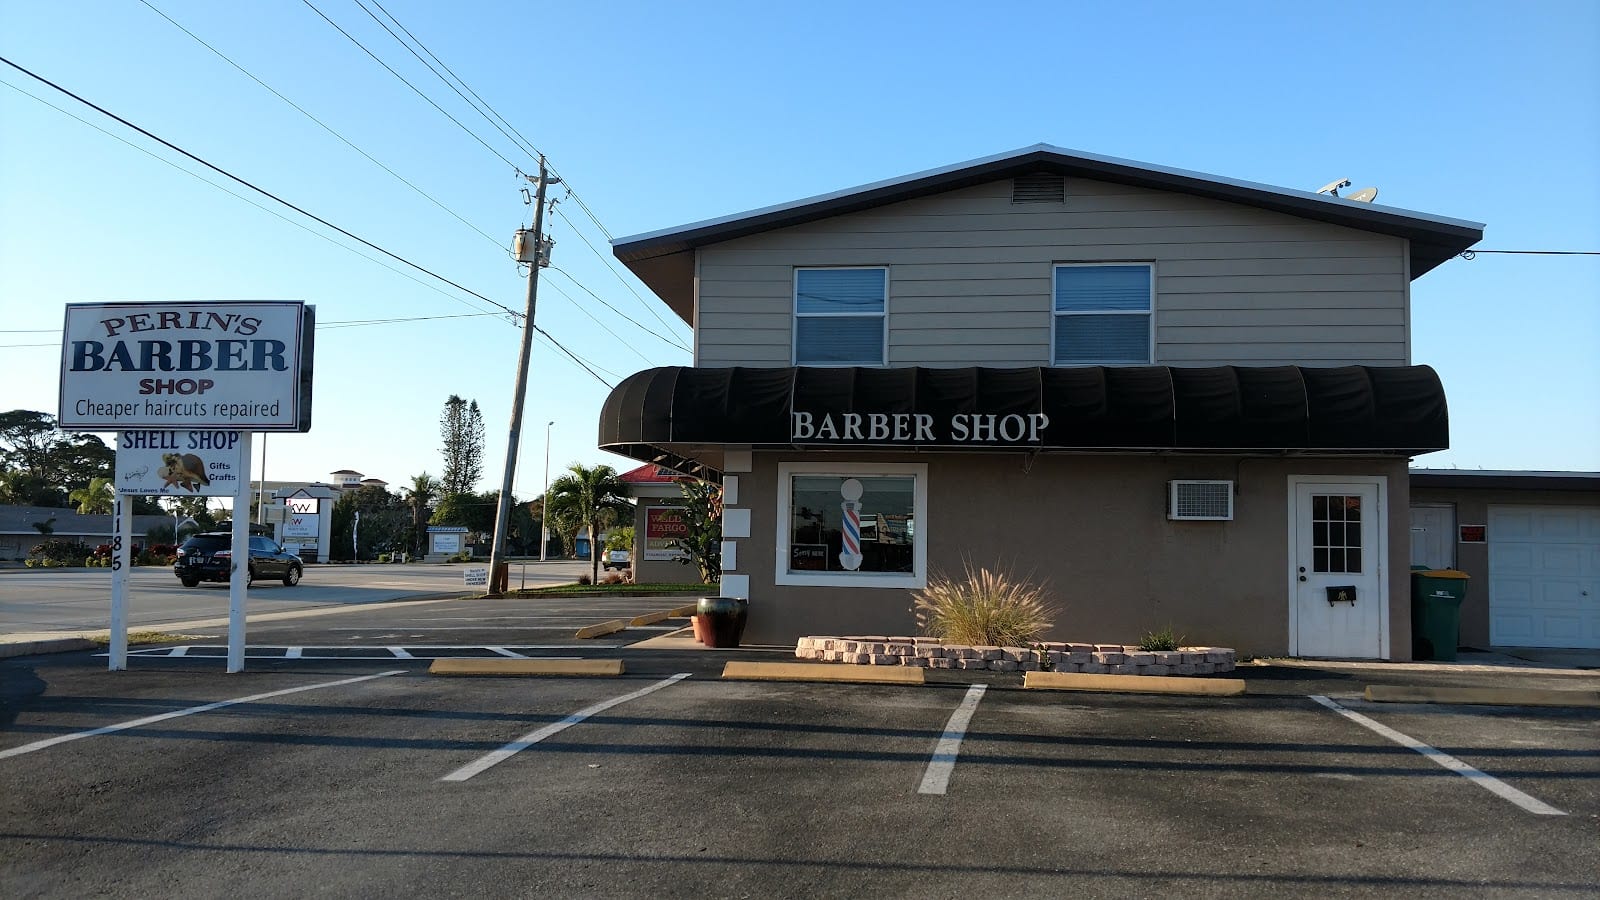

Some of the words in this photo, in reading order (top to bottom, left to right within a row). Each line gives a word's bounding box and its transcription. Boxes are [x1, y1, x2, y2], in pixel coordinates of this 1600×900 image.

[100, 311, 262, 337] PERIN'S
[70, 339, 289, 372] BARBER
[139, 378, 214, 395] SHOP
[76, 399, 139, 419] Cheaper
[145, 399, 207, 417] haircuts
[214, 400, 279, 420] repaired
[793, 411, 936, 441] BARBER
[951, 413, 1049, 442] SHOP
[123, 431, 179, 449] SHELL
[188, 431, 239, 449] SHOP
[209, 462, 231, 470] Gifts
[209, 473, 236, 481] Crafts
[651, 524, 687, 532] FARGO
